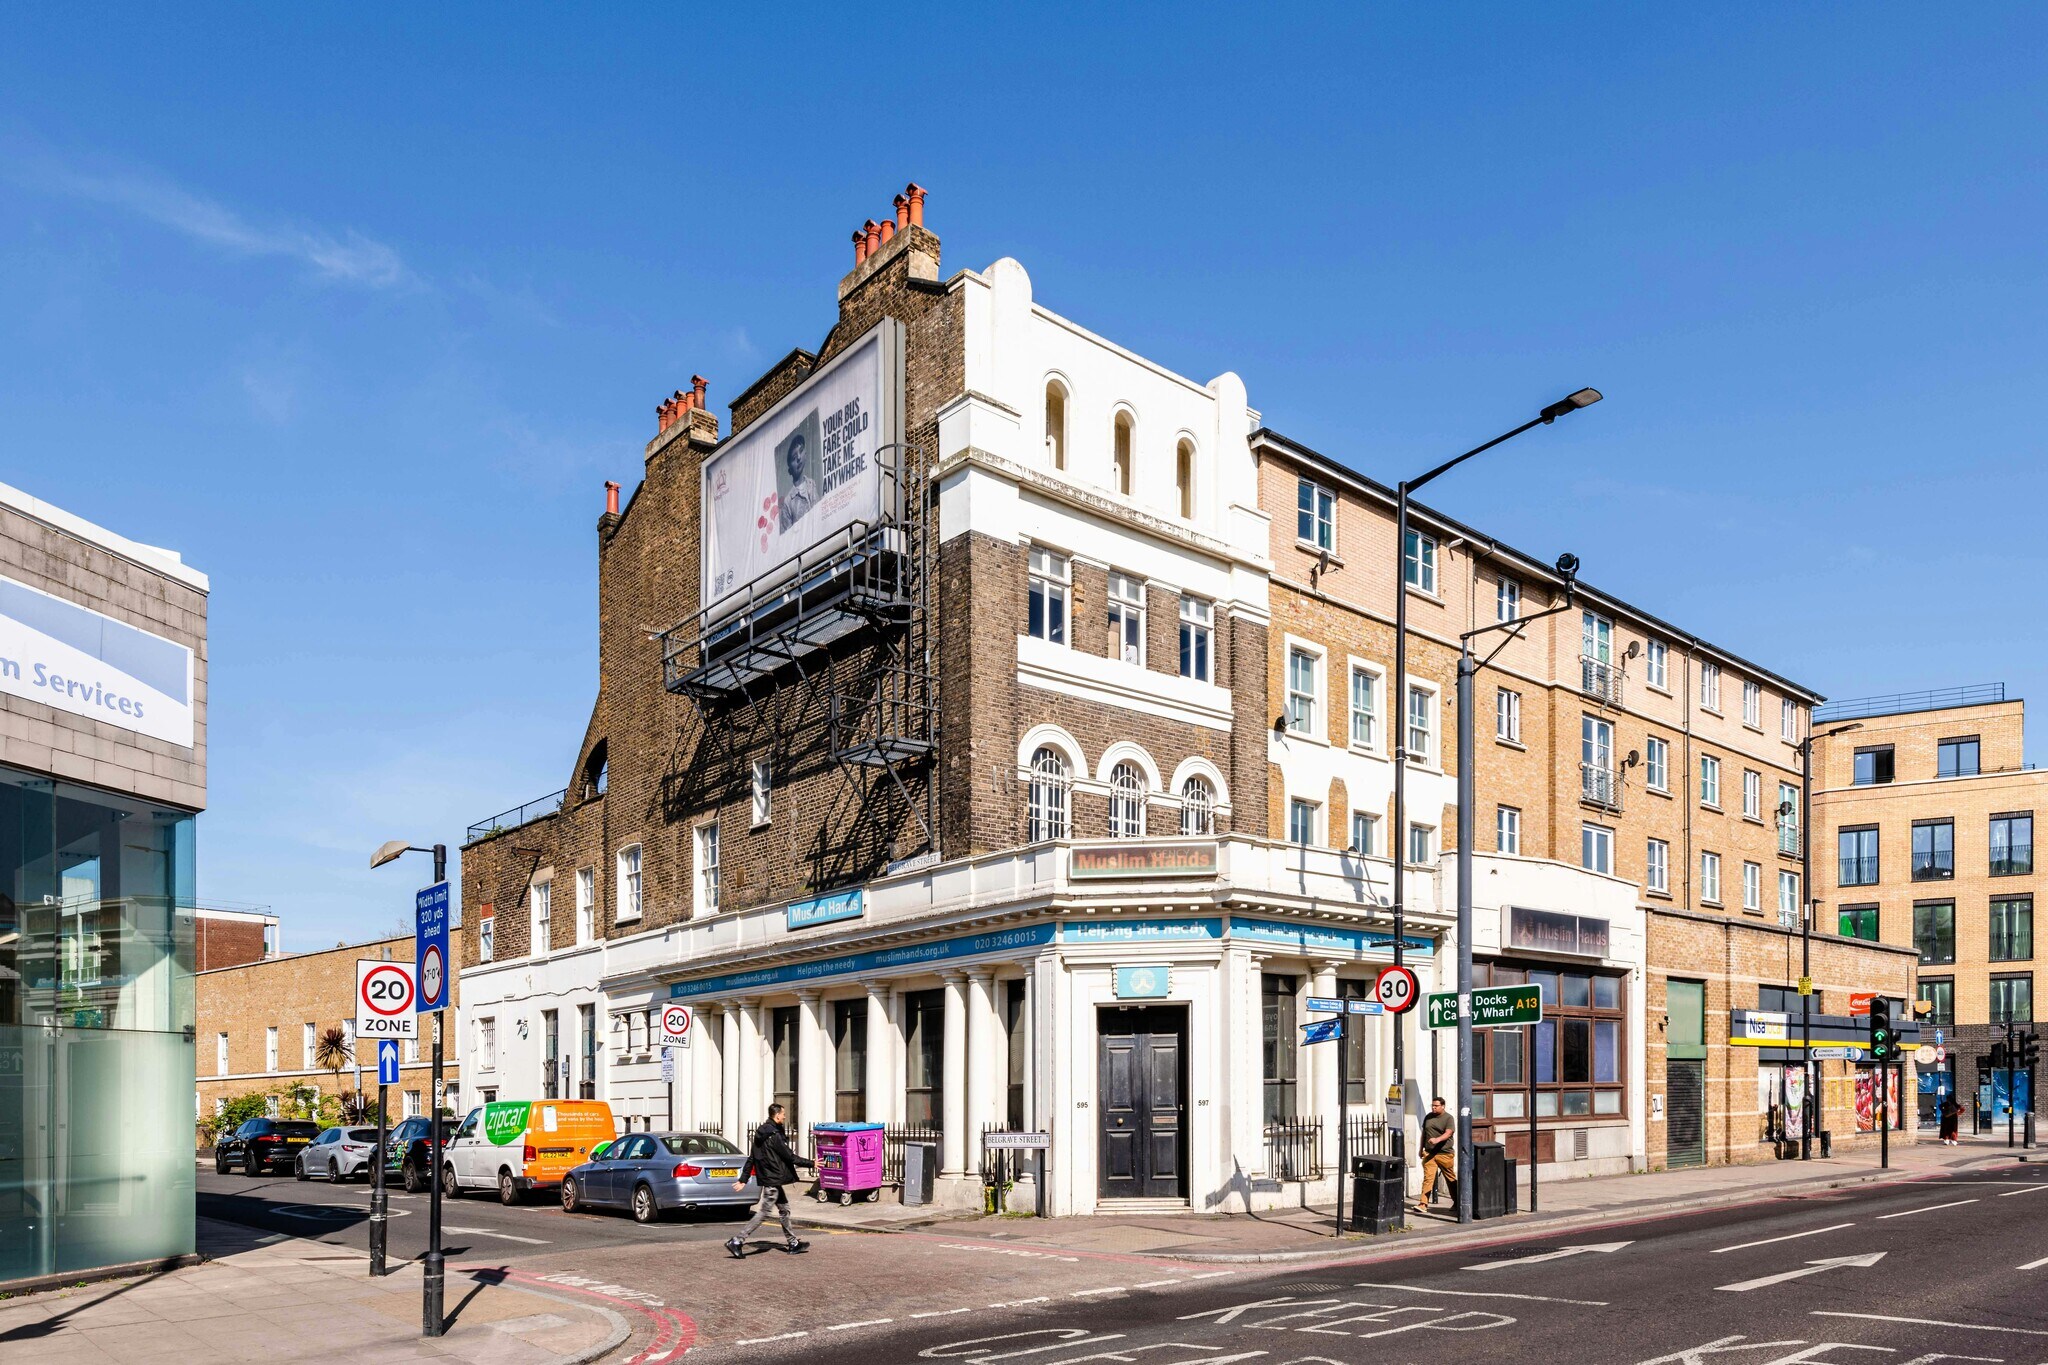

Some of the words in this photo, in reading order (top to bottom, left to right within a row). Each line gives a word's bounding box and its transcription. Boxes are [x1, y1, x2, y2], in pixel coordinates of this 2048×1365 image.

[822, 409, 843, 437] YOUR
[844, 396, 860, 423] BUS
[822, 430, 841, 457] FARE
[842, 411, 868, 444] COULD
[822, 449, 841, 476] TAKE
[843, 440, 855, 462] ME
[822, 453, 868, 496] ANYWHERE.
[33, 662, 144, 718] Services
[917, 855, 938, 865] STREET
[1079, 853, 1146, 870] Muslim
[1151, 851, 1211, 869] Hands
[417, 894, 434, 908] Width
[792, 904, 826, 923] Muslim
[828, 898, 859, 916] Hands
[421, 910, 432, 923] 320
[433, 907, 443, 922] yds
[424, 922, 440, 938] ahead
[1077, 923, 1133, 939] Helping
[1136, 922, 1160, 936] the
[1163, 921, 1207, 937] needy
[1251, 924, 1337, 943] muslimhands.org.uk
[1538, 923, 1574, 942] Muslim
[1579, 928, 1607, 946] Hands
[678, 985, 687, 994] 020
[687, 983, 700, 993] 3246
[726, 970, 779, 986] muslimhands.org.uk
[797, 966, 822, 976] Helping
[822, 963, 834, 972] the
[834, 959, 856, 971] needy
[875, 943, 949, 964] muslimhands.org.uk
[975, 939, 990, 949] 020
[991, 934, 1012, 947] 3246
[1014, 931, 1036, 944] 0015
[371, 980, 405, 1000] 20
[1381, 979, 1408, 998] 30
[1475, 995, 1508, 1006] Docks
[1516, 997, 1538, 1009] A13
[1482, 1005, 1514, 1018] Wharf
[365, 1018, 411, 1032] ZONE
[668, 1014, 685, 1026] 20
[663, 1035, 687, 1044] ZONE
[487, 1105, 527, 1135] zipcar
[1176, 1297, 1518, 1338] KEEP
